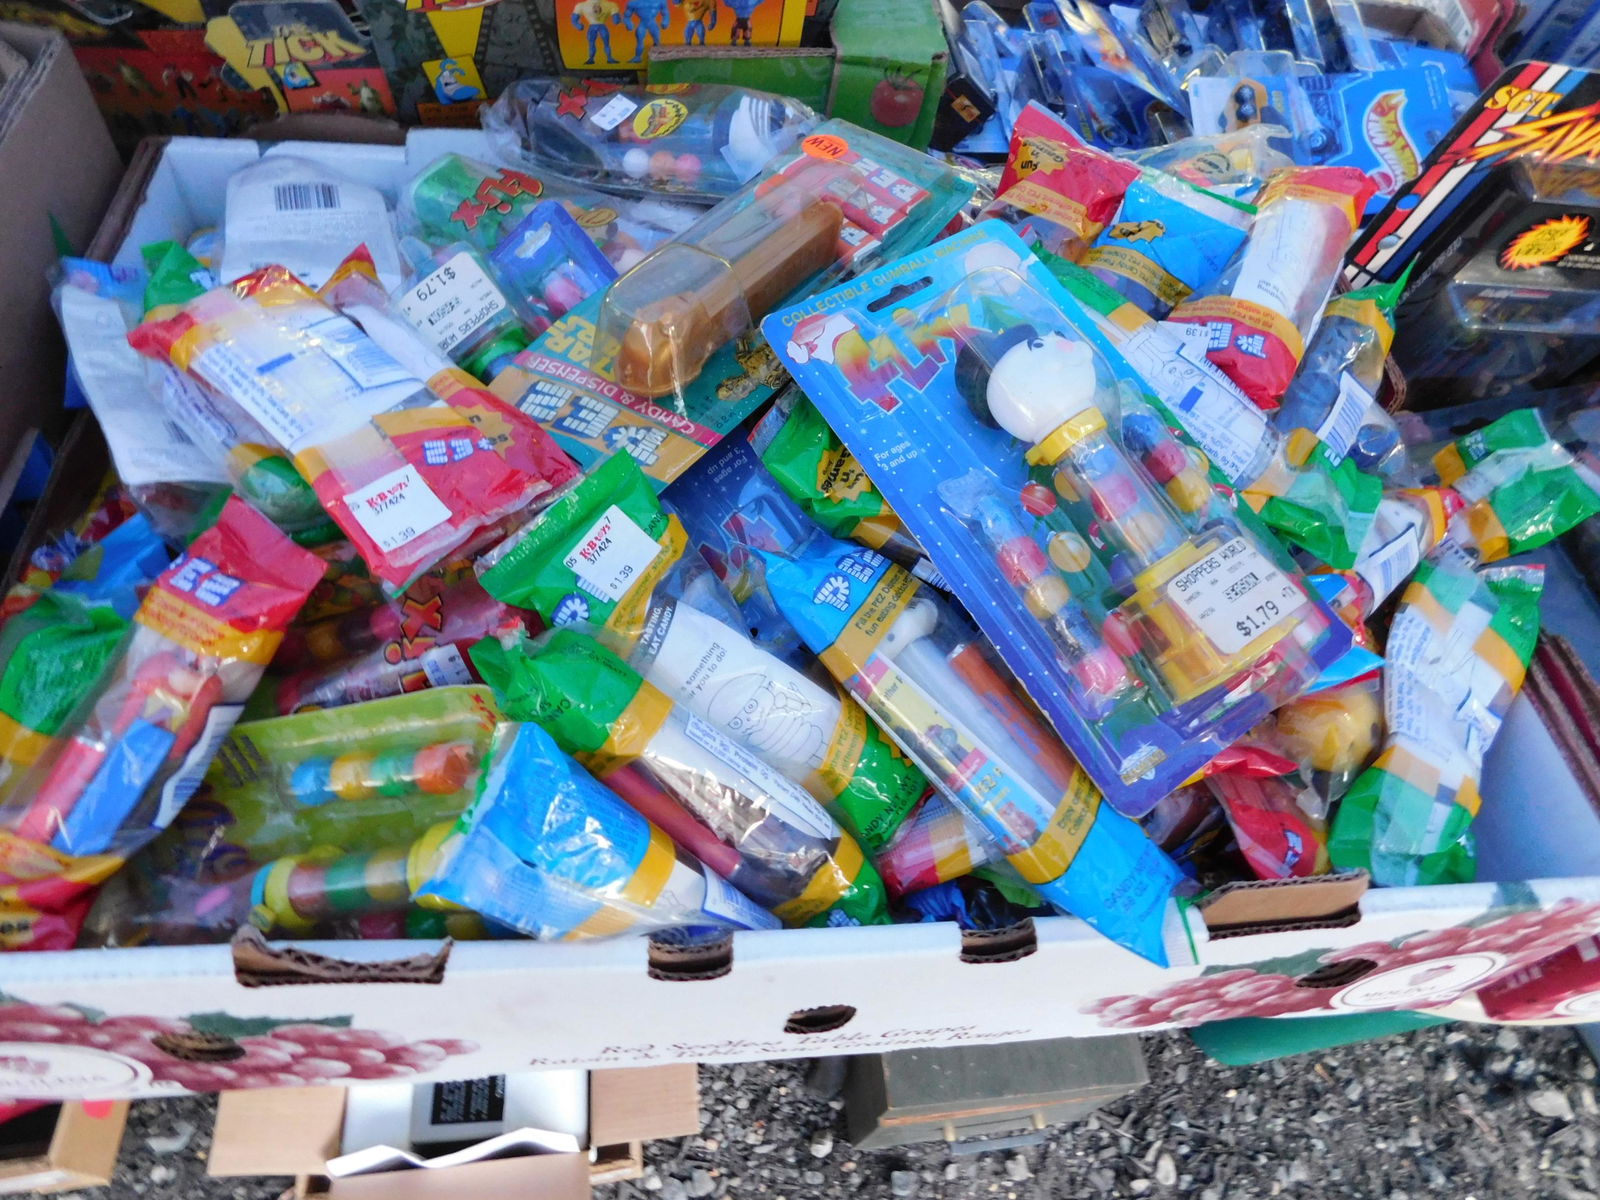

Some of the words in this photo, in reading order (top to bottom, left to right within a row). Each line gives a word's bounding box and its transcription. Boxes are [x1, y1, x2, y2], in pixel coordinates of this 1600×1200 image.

[247, 31, 369, 69] TICK
[1484, 84, 1565, 118] SGT.
[808, 137, 843, 156] NEW
[1020, 158, 1040, 171] Fun
[416, 266, 457, 302] $1.79
[782, 282, 871, 327] COLLECTIBLE
[872, 257, 938, 287] GUMBALL
[935, 229, 989, 259] MACHINE
[458, 301, 499, 335] SHOPPERS
[526, 356, 617, 397] DISPENSER
[620, 392, 632, 404] &
[515, 379, 670, 467] PEZ
[635, 402, 696, 435] CANDY
[721, 451, 734, 465] and
[734, 456, 747, 468] For
[874, 451, 889, 462] For
[890, 441, 911, 455] ages
[889, 456, 906, 468] and
[905, 451, 918, 464] up
[707, 463, 719, 474] up
[714, 464, 733, 484] ages
[821, 449, 851, 492] Games
[565, 557, 577, 568] 05
[587, 538, 612, 565] 377424
[1175, 557, 1221, 592] SHOPPERS
[1219, 540, 1247, 560] WORLD
[864, 609, 875, 620] the
[872, 593, 886, 608] PEZ
[865, 622, 878, 637] fun
[877, 601, 896, 622] eating
[1236, 600, 1279, 636] $1.79
[686, 642, 721, 685] something
[696, 678, 707, 697] you
[709, 663, 718, 675] to
[861, 815, 884, 839] ANDY
[602, 1043, 656, 1053] Red
[666, 1038, 783, 1050] Seedless
[798, 1032, 871, 1044] Table
[879, 1024, 977, 1038] Grapes
